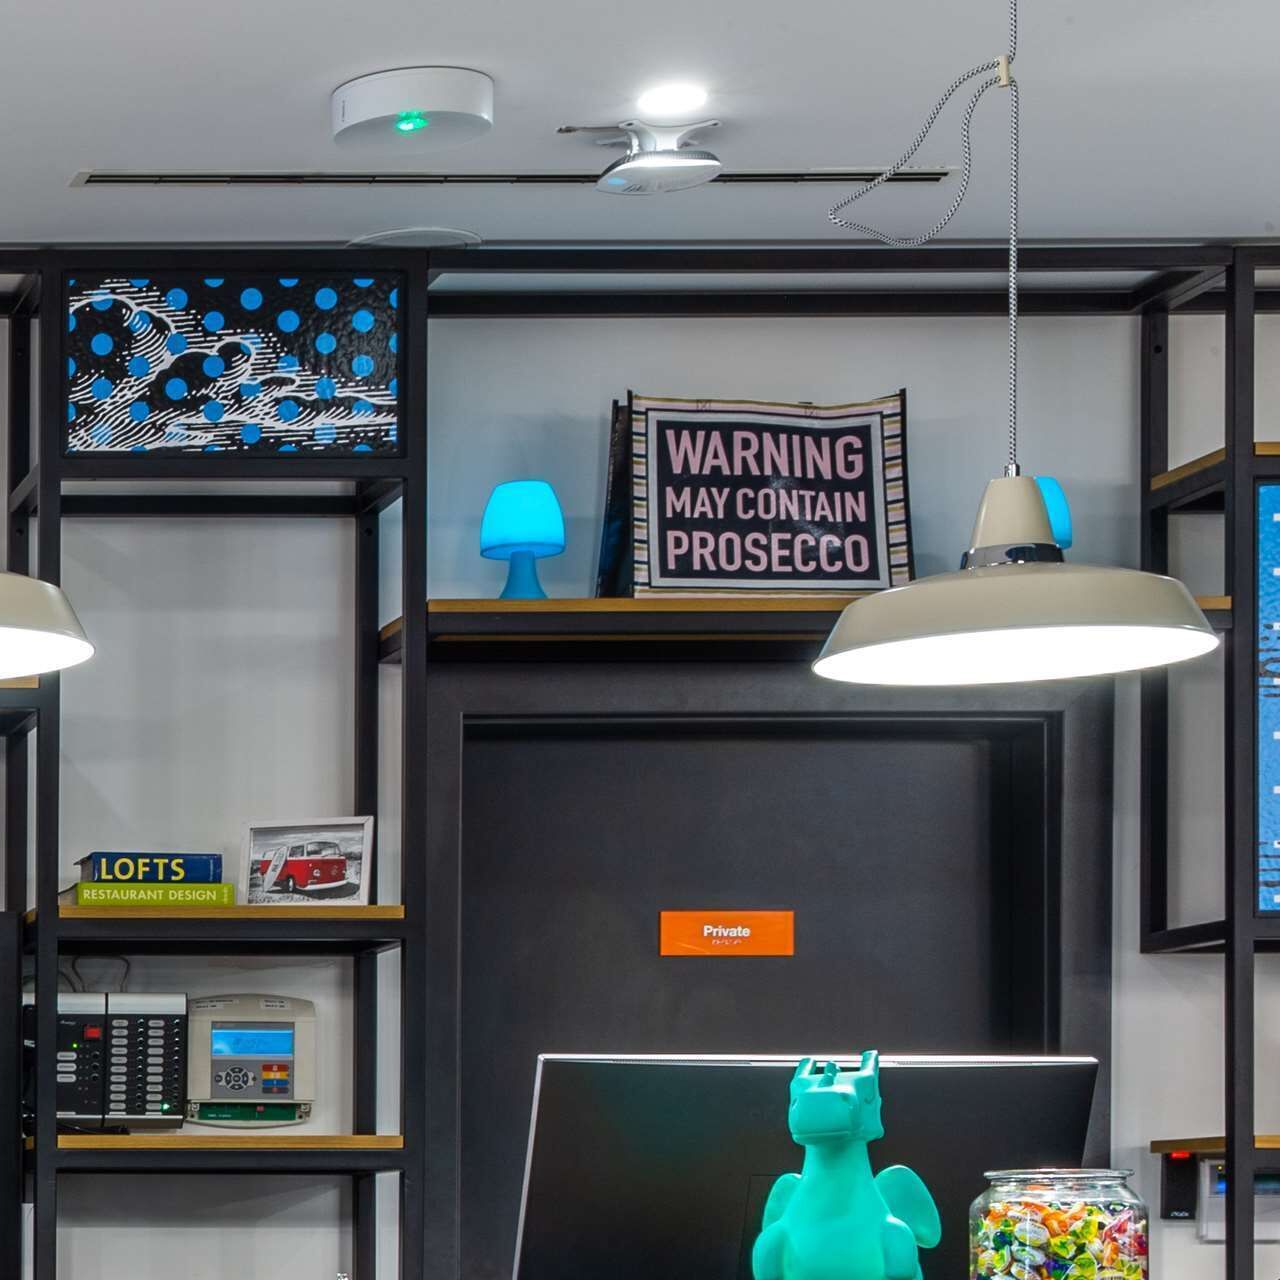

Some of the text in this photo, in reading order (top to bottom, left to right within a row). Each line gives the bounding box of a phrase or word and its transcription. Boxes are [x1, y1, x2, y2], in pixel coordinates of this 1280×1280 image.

[665, 429, 864, 480] WARNING
[665, 486, 867, 522] MAY CONTAIN
[666, 530, 870, 573] PROSECCO
[100, 858, 185, 881] LOFTS
[83, 889, 164, 900] RESTAURANT
[169, 890, 217, 901] DESIGN
[703, 925, 751, 937] Private
